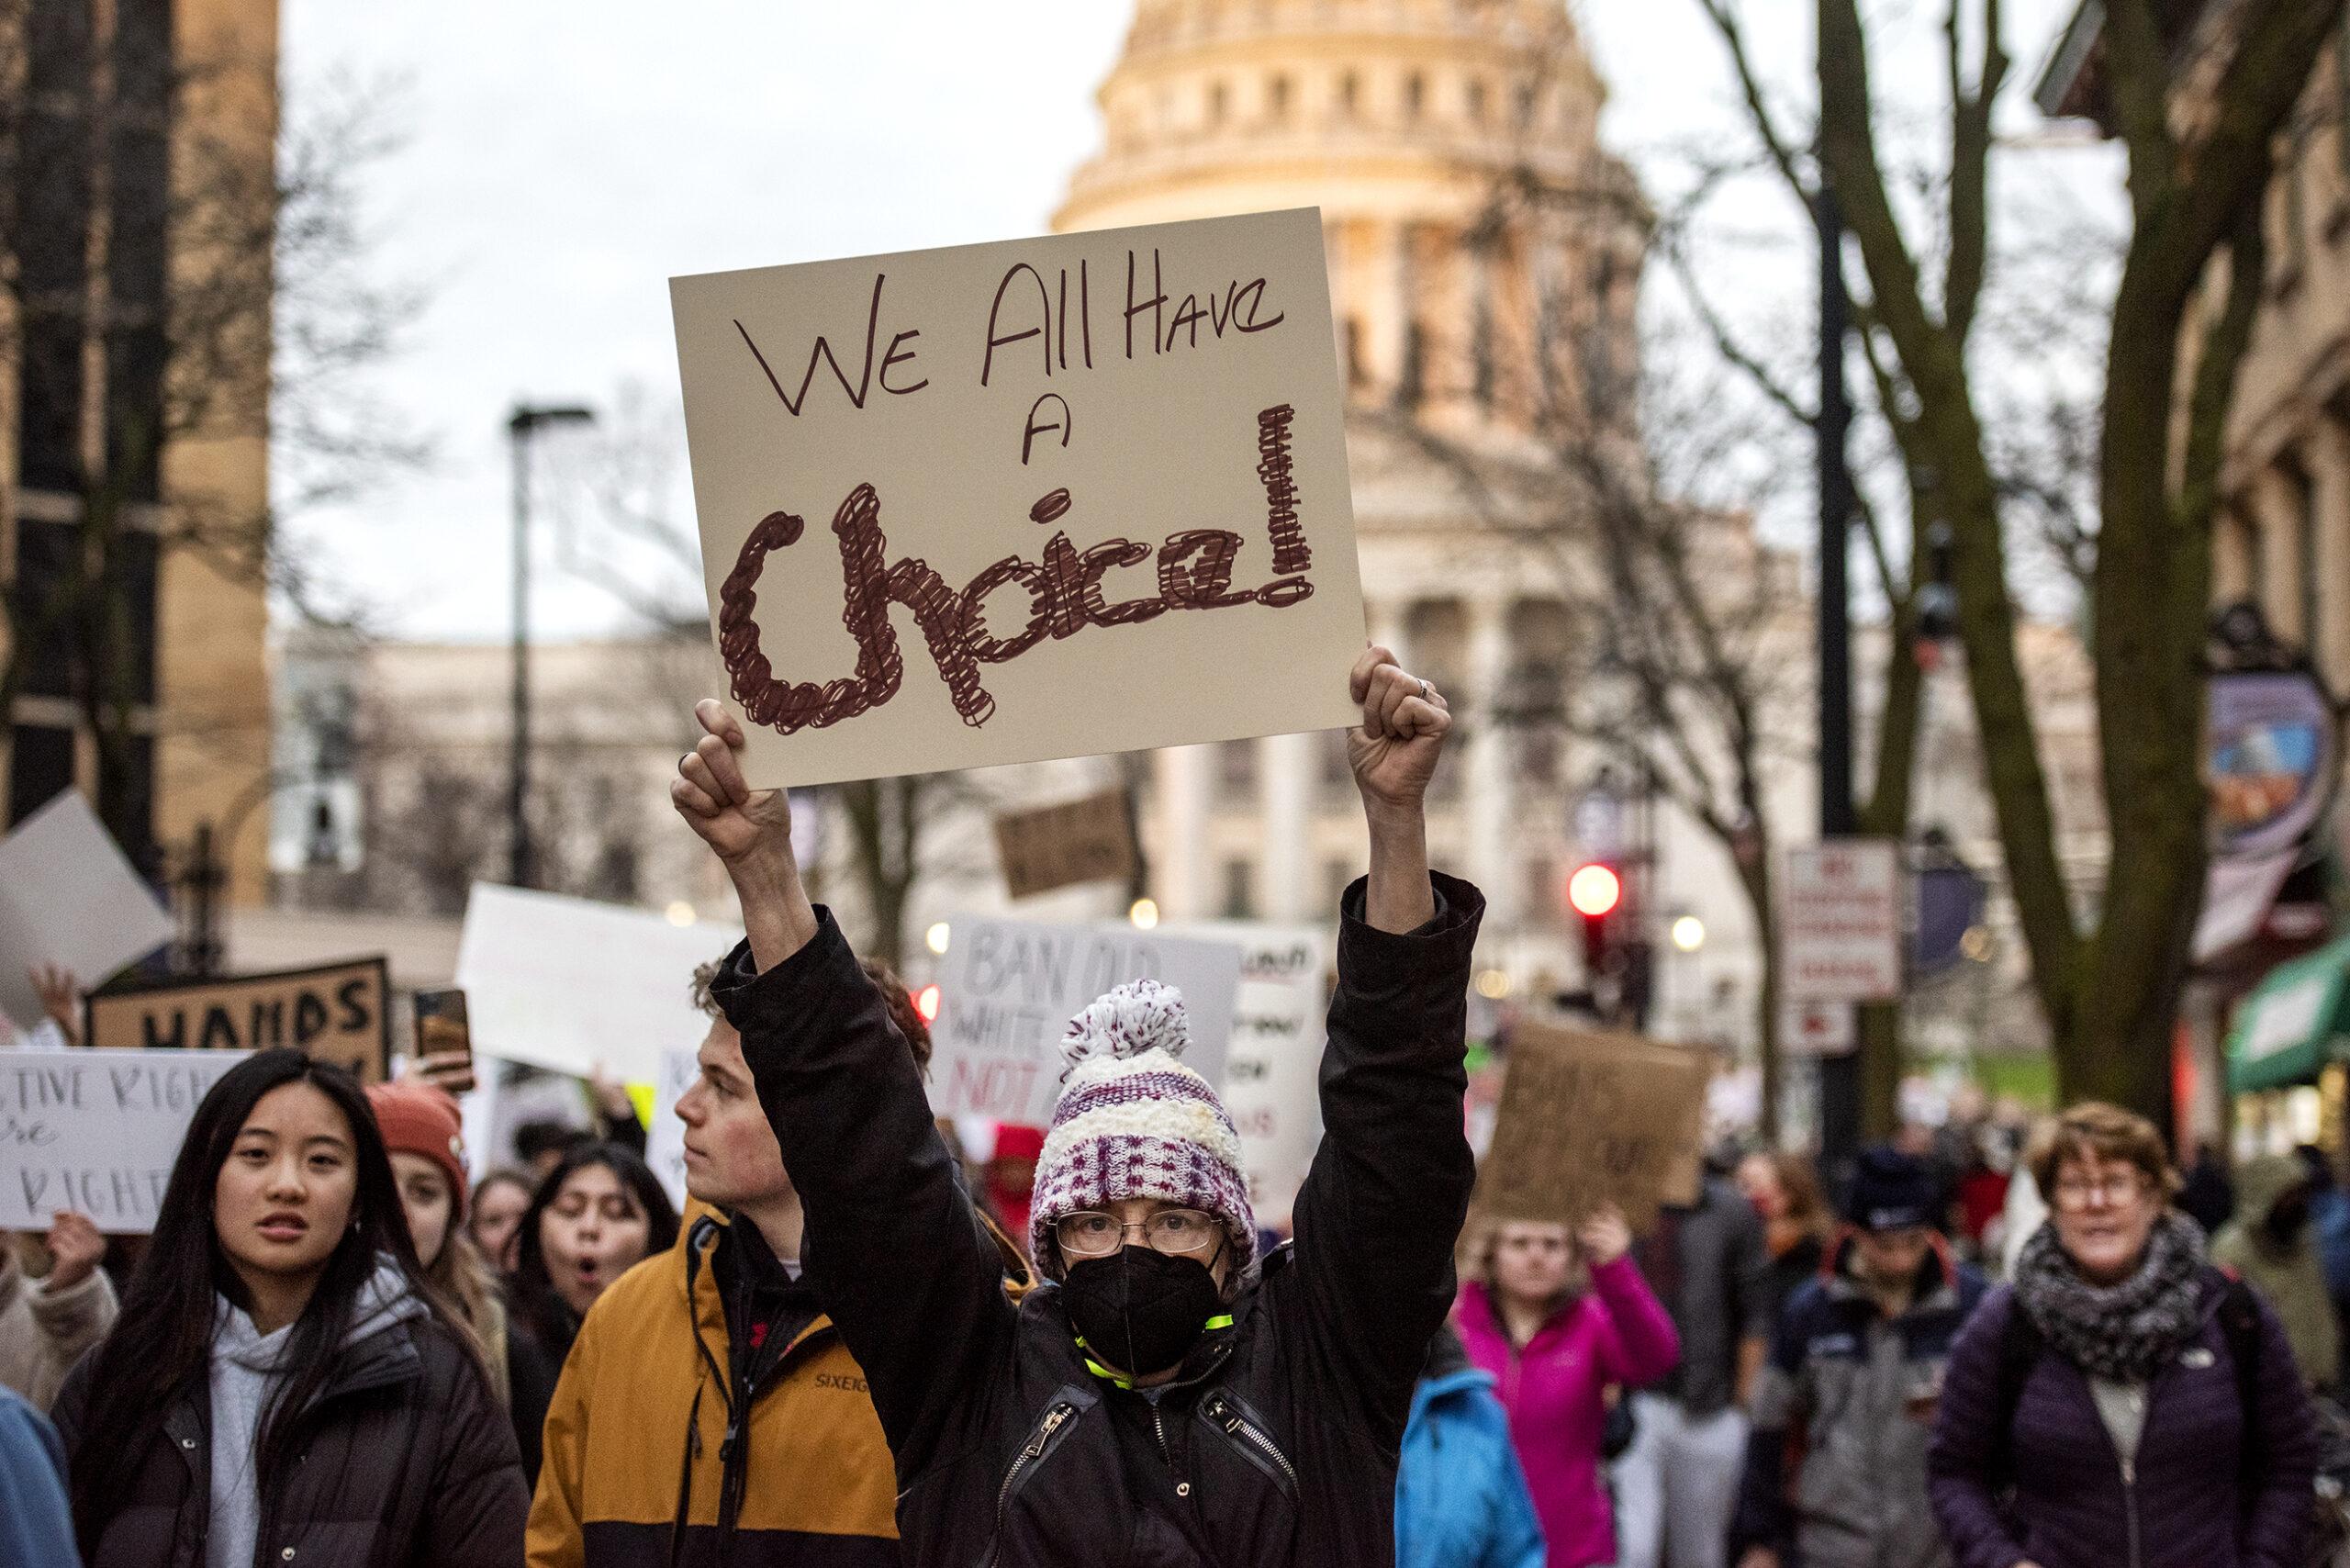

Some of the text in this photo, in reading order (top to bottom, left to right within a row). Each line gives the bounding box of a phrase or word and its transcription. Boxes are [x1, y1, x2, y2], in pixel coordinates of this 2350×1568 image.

[1023, 393, 1071, 465] A
[721, 404, 1315, 735] Choice!
[964, 924, 1078, 1008] BAN
[143, 979, 369, 1048] HANDS
[0, 1063, 214, 1113] TIVE RIGH
[946, 1053, 1040, 1115] NOT
[815, 1373, 869, 1393] SIXEIG
